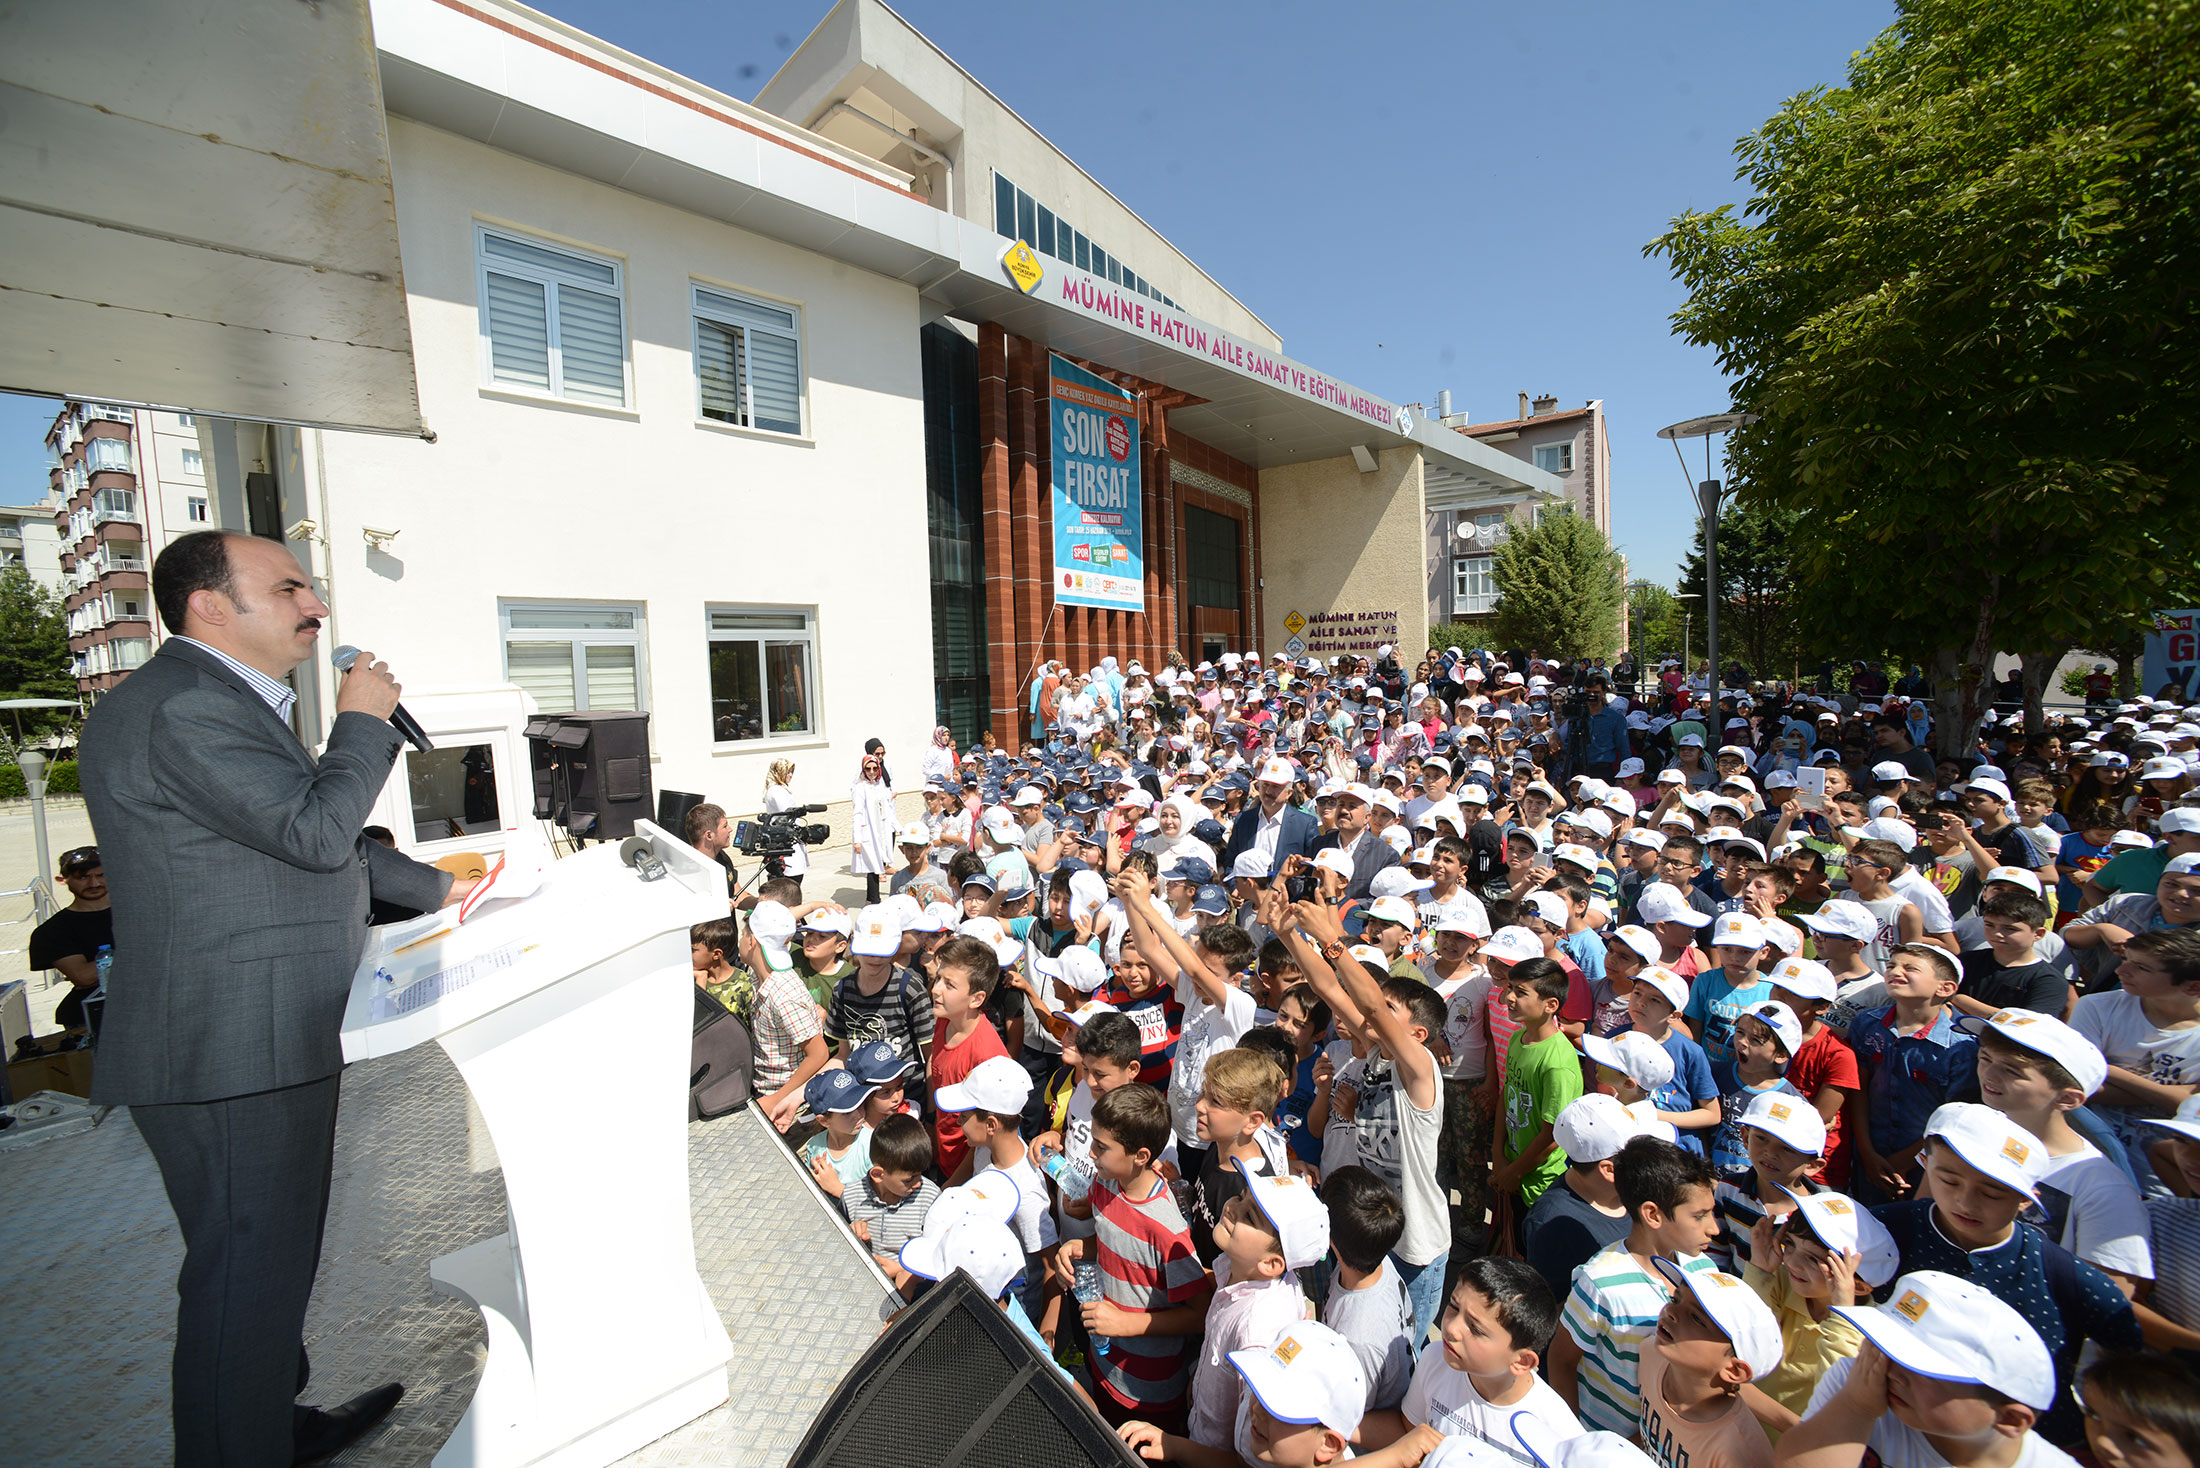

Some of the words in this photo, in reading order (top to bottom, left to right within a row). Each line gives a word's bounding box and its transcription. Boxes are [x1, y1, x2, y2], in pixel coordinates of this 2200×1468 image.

[1062, 275, 1144, 329] MÜMİNE
[1151, 310, 1207, 353] HATUN
[1211, 335, 1243, 367] AİLE
[1246, 351, 1289, 385] SANAT
[1291, 368, 1306, 392] VE
[1309, 375, 1348, 409] EĞİTİM
[1350, 393, 1391, 426] MERKEZİ
[1063, 408, 1105, 458] SON
[1065, 460, 1130, 509] FIRSAT
[1073, 547, 1089, 558] SPOR
[1308, 611, 1354, 624] MÜMİNE
[1358, 610, 1397, 621] HATUN
[1309, 626, 1335, 638] AİLE
[1338, 625, 1378, 637] SANAT
[1382, 625, 1397, 635] VE
[1308, 641, 1347, 651] EĞİTİM
